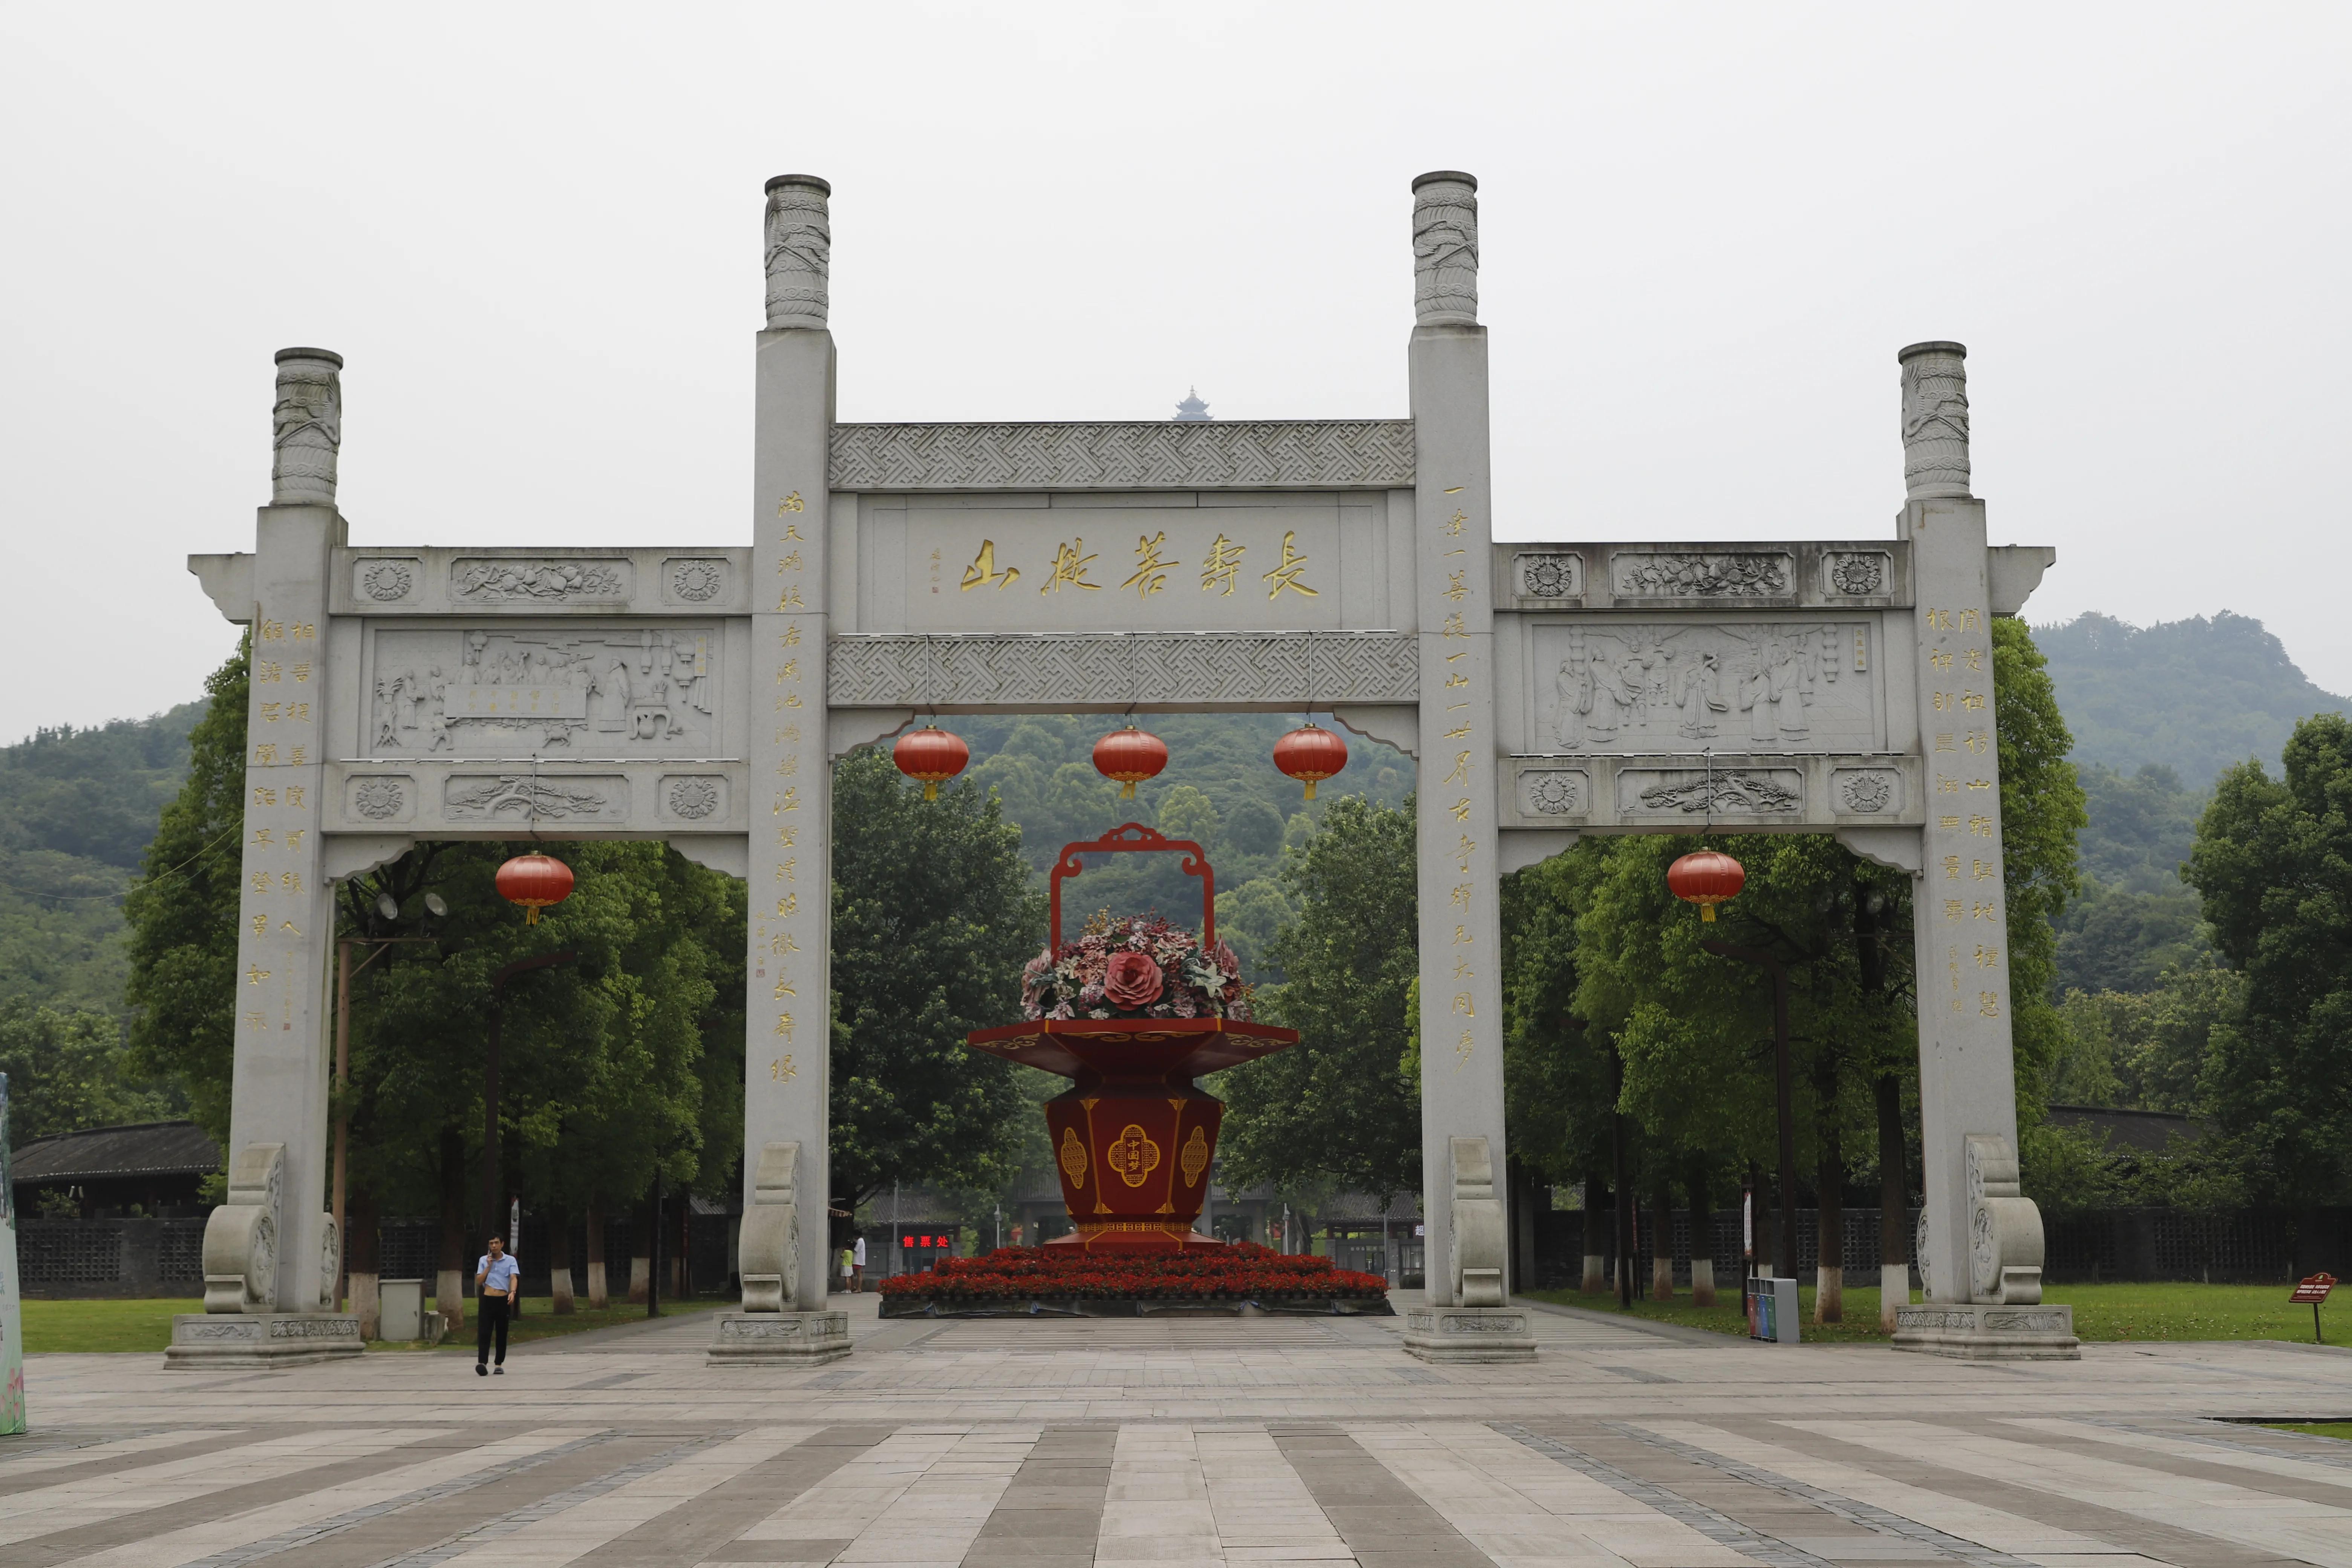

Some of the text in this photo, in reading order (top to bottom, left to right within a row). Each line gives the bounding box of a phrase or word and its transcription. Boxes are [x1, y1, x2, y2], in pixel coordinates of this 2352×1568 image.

[1126, 1140, 1141, 1172] 中国梦
[903, 1236, 948, 1248] 售票处
